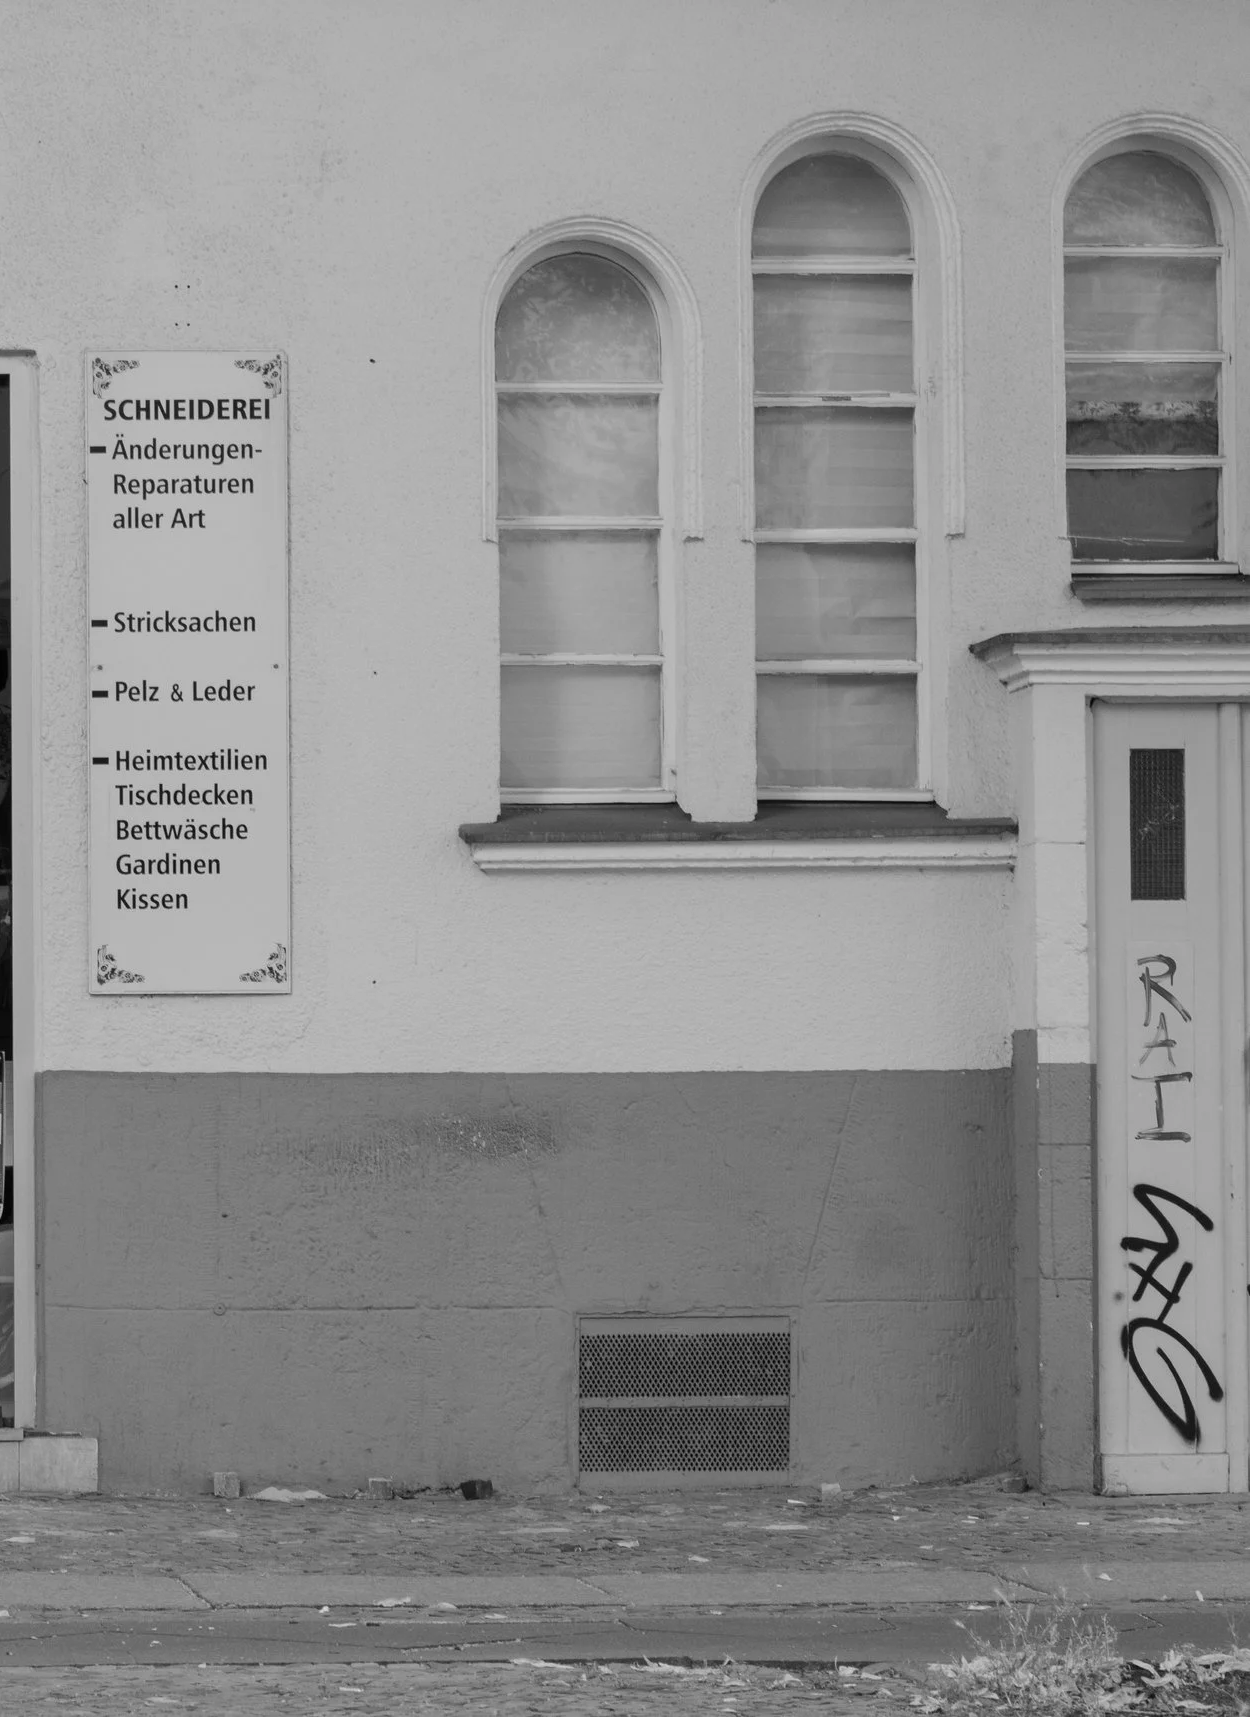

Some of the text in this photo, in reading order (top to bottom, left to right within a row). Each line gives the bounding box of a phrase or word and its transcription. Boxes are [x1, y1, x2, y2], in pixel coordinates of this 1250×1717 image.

[103, 398, 271, 421] SCHNEIDEREI
[112, 434, 263, 465] Änderungen-
[113, 474, 254, 501] Reparaturen
[112, 506, 206, 529] aller Art
[114, 610, 256, 633] Stricksachen
[115, 680, 256, 703] Pelz & Leder
[115, 749, 268, 771] Heimtextilien
[115, 784, 253, 805] Tischdecken
[116, 817, 248, 840] Bettwäsche
[116, 853, 221, 875] Gardinen
[117, 888, 188, 910] Kissen
